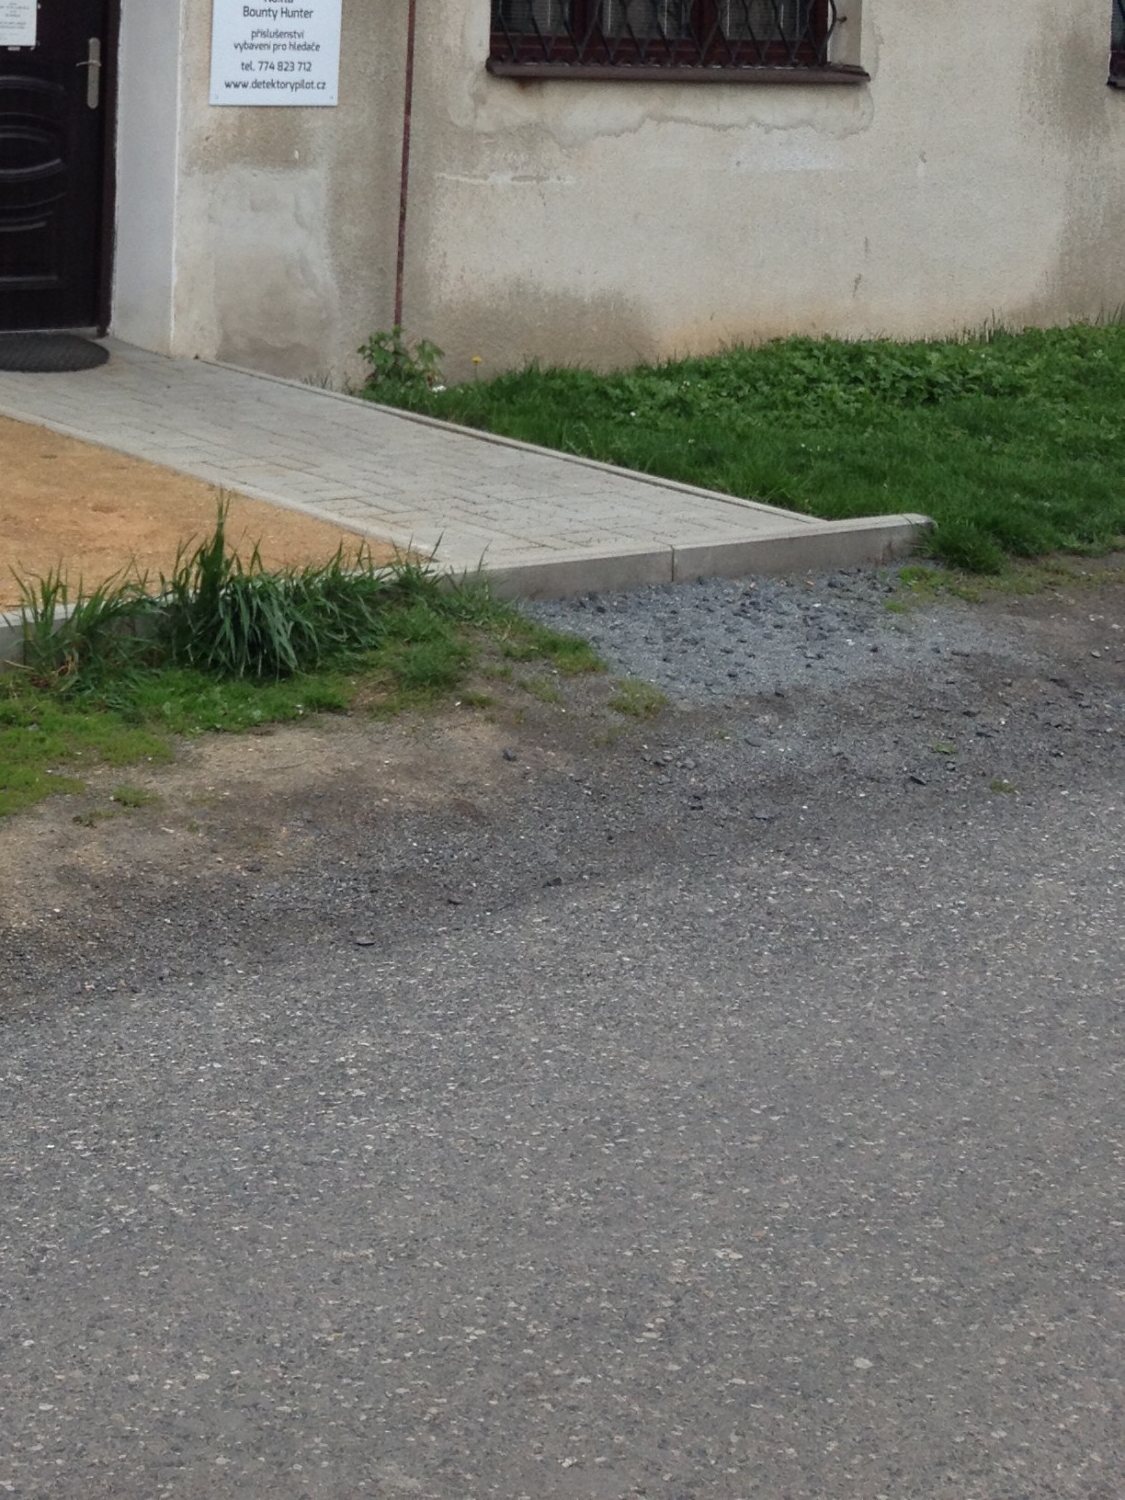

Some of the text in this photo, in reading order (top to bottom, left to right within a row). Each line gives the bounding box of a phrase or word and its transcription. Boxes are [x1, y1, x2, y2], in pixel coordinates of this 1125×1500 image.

[243, 5, 314, 21] Bounty Hunter
[272, 43, 287, 54] pro
[289, 42, 321, 52] hledače
[241, 61, 312, 72] tel. 774 823 712
[224, 79, 327, 93] www.detektorypilot.cz
